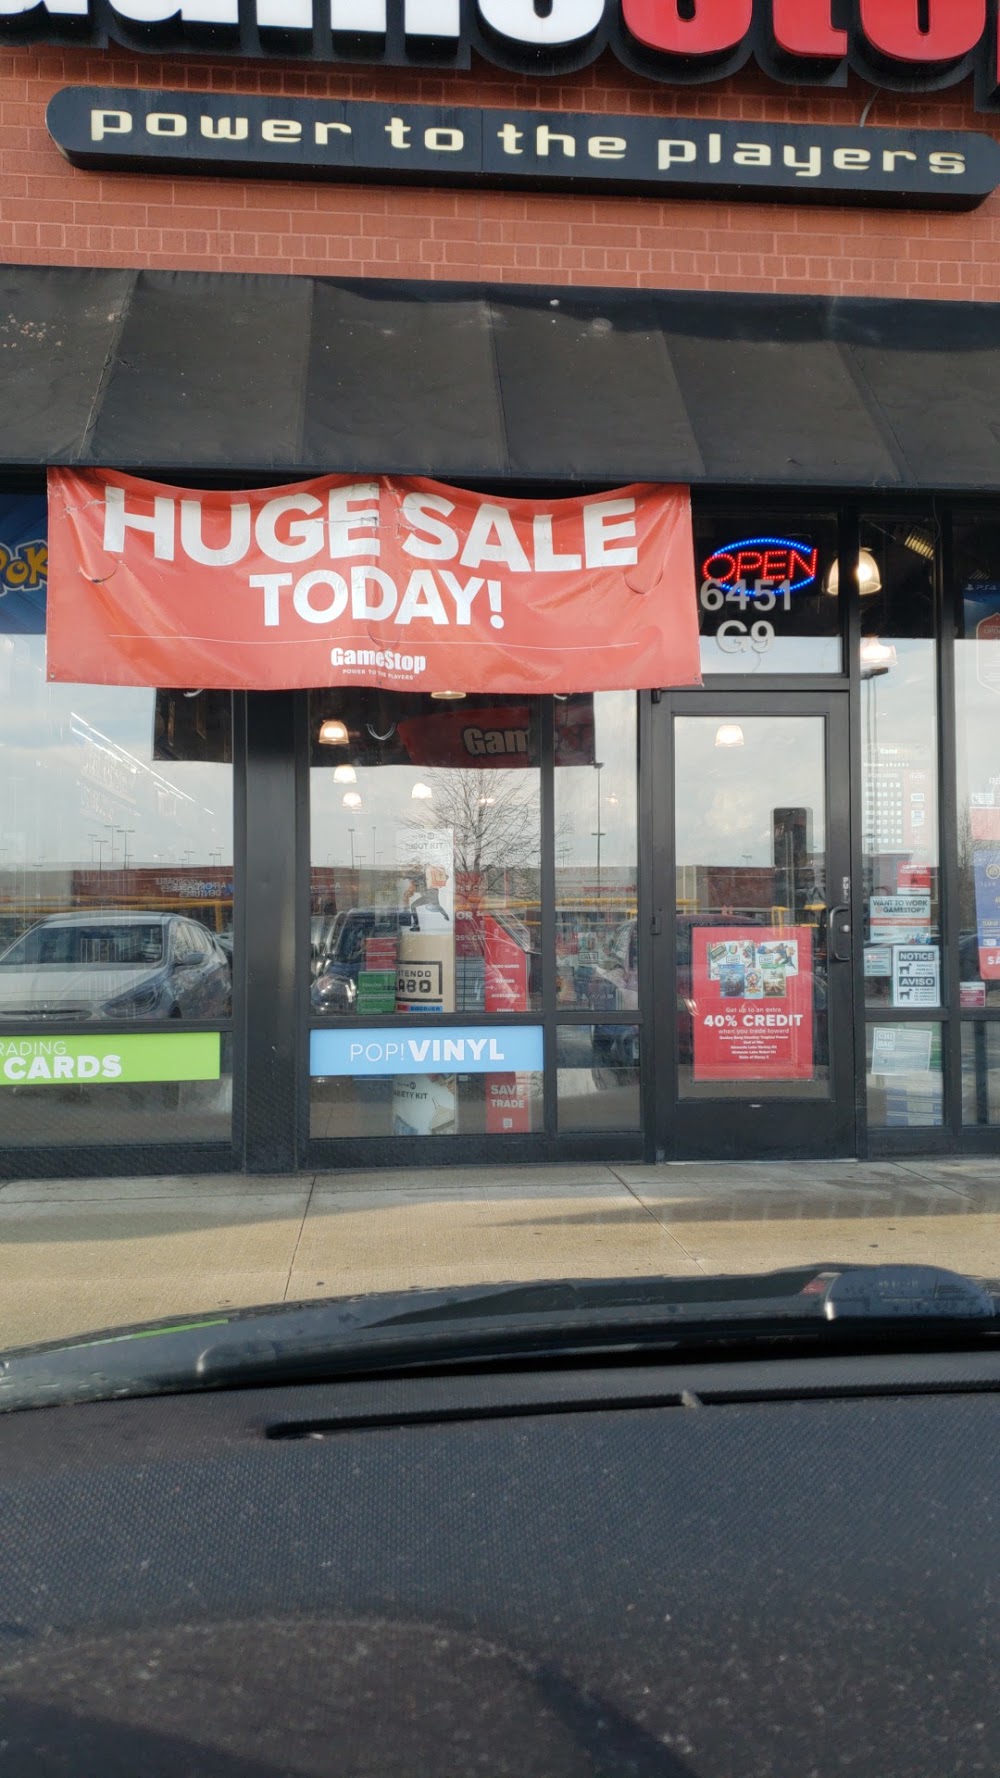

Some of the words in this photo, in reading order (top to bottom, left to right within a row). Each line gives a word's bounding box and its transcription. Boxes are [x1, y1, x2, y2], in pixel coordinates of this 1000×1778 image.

[91, 109, 352, 145] power
[385, 117, 464, 151] to
[497, 123, 627, 159] the
[658, 133, 966, 177] players
[103, 482, 381, 567] HUGE
[401, 492, 639, 572] SALE
[702, 548, 818, 583] OPEN
[249, 565, 505, 629] TODAY!
[700, 578, 791, 611] 6451
[716, 620, 775, 653] G9
[330, 647, 427, 674] GameStop
[900, 952, 935, 961] NOTICE
[398, 970, 431, 978] TENDO
[901, 978, 933, 986] AVISO
[704, 1014, 738, 1027] 40%
[742, 1014, 803, 1027] CREDIT
[3, 1054, 122, 1080] CARDS
[416, 1092, 429, 1100] KIT
[491, 1085, 524, 1095] SAVE
[491, 1099, 525, 1108] TRADE
